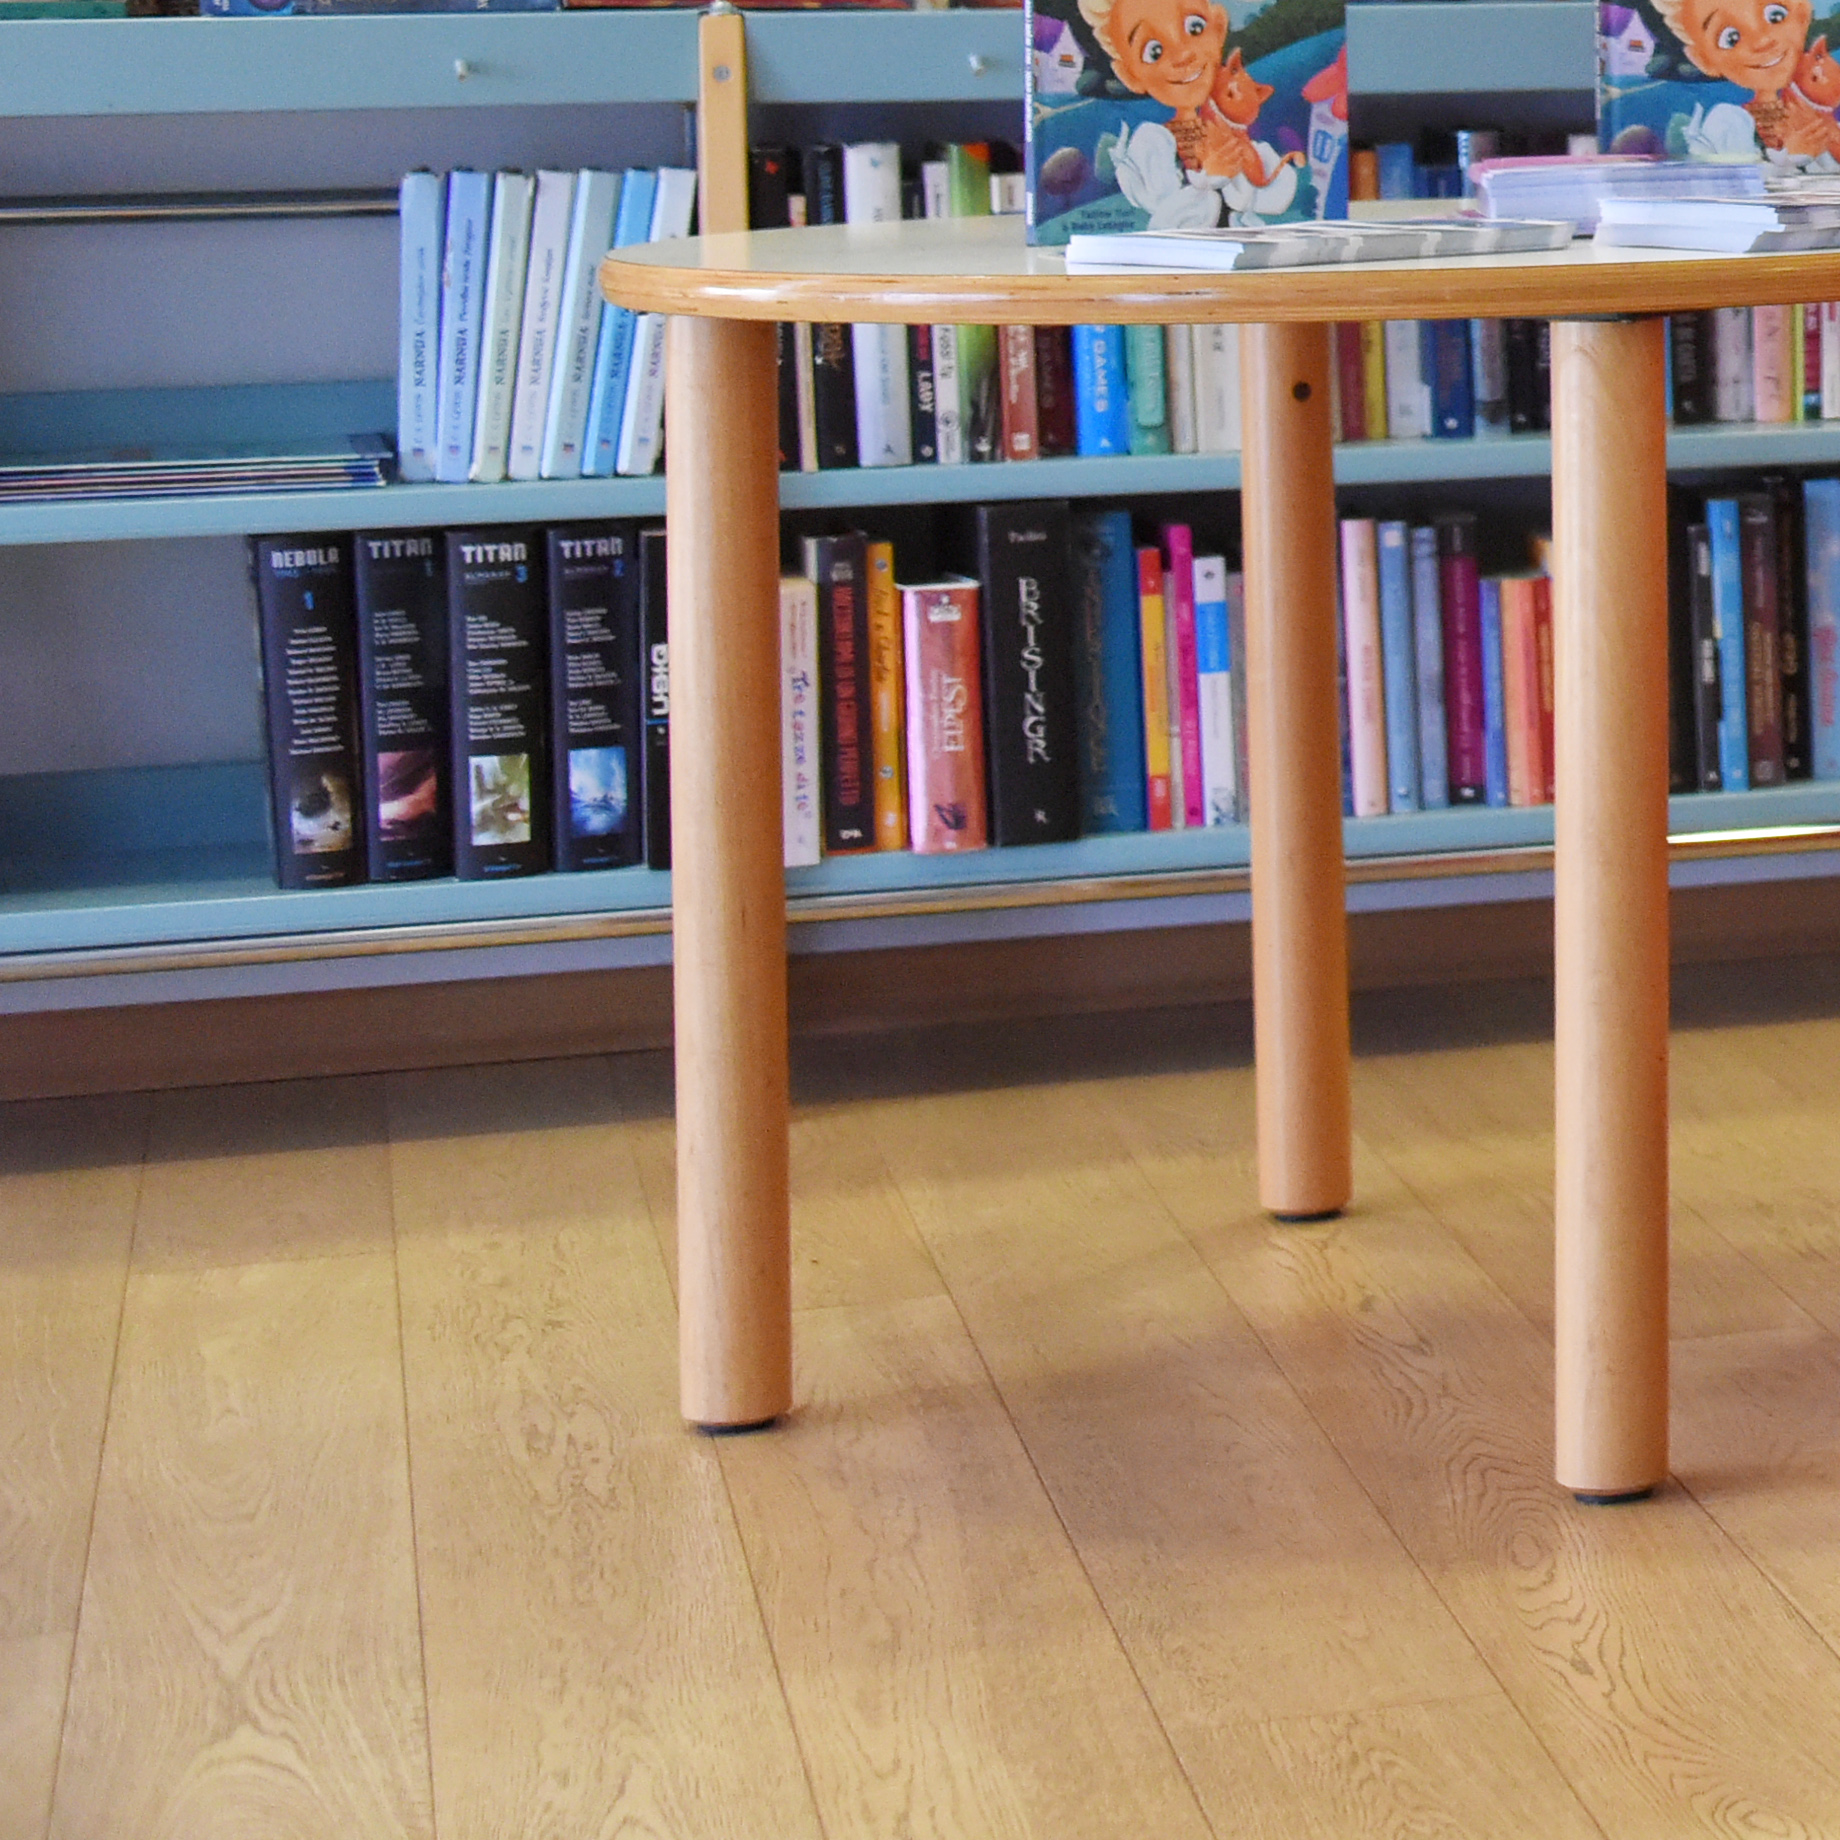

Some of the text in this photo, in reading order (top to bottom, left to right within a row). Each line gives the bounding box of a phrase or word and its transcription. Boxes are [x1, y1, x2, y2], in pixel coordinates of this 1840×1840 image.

[1093, 340, 1108, 412] GAMES
[916, 370, 933, 413] LADY
[271, 547, 340, 569] NEBULA
[368, 538, 433, 560] TITAN
[460, 543, 528, 564] TITAN
[560, 537, 624, 560] TITAN
[515, 564, 529, 583] 3
[1016, 577, 1051, 765] BRISINGR
[791, 710, 809, 766] tazze
[795, 772, 809, 790] di
